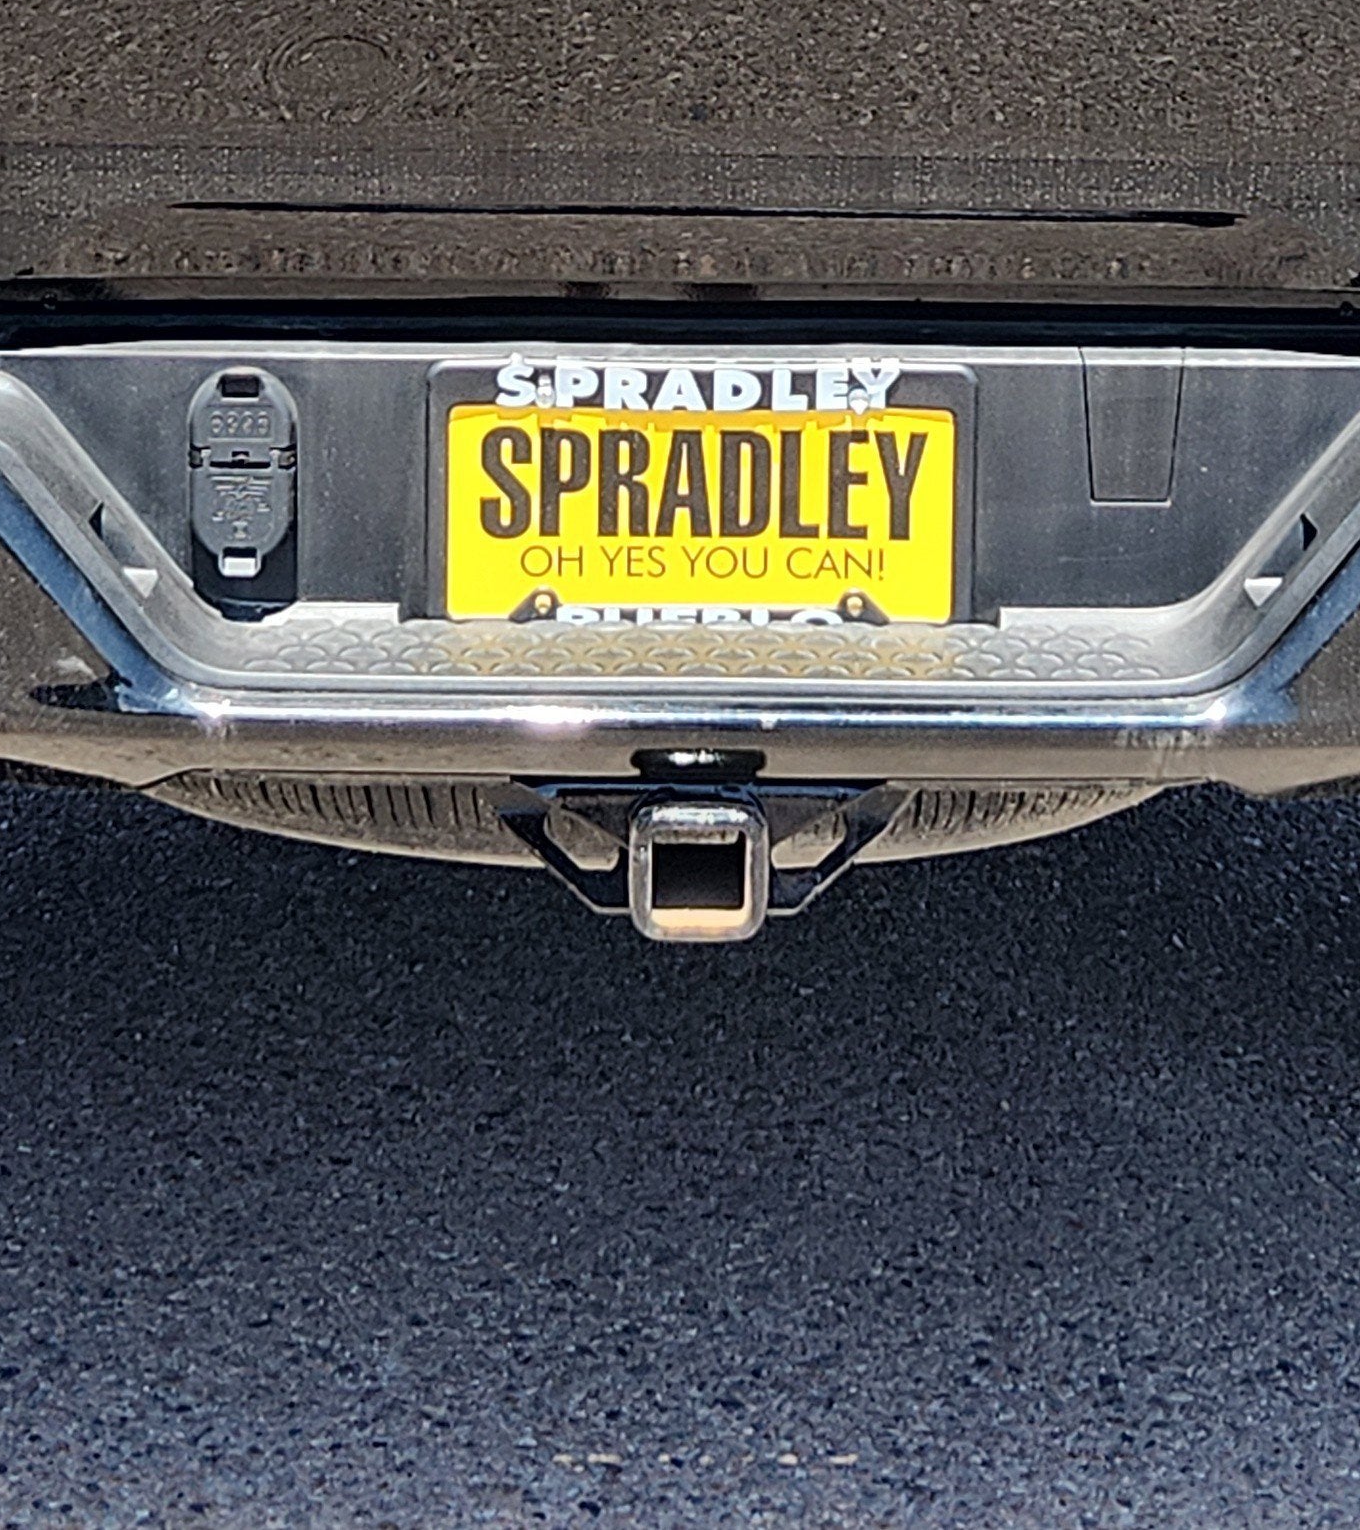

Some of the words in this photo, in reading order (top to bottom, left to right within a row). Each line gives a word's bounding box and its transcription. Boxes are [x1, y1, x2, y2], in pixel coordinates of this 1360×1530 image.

[495, 360, 901, 411] SPRADLEY
[479, 426, 929, 541] SPRADLEY
[520, 545, 584, 578] OH
[600, 546, 666, 578] YES
[681, 546, 769, 579] YOU
[785, 547, 886, 582] CAN!
